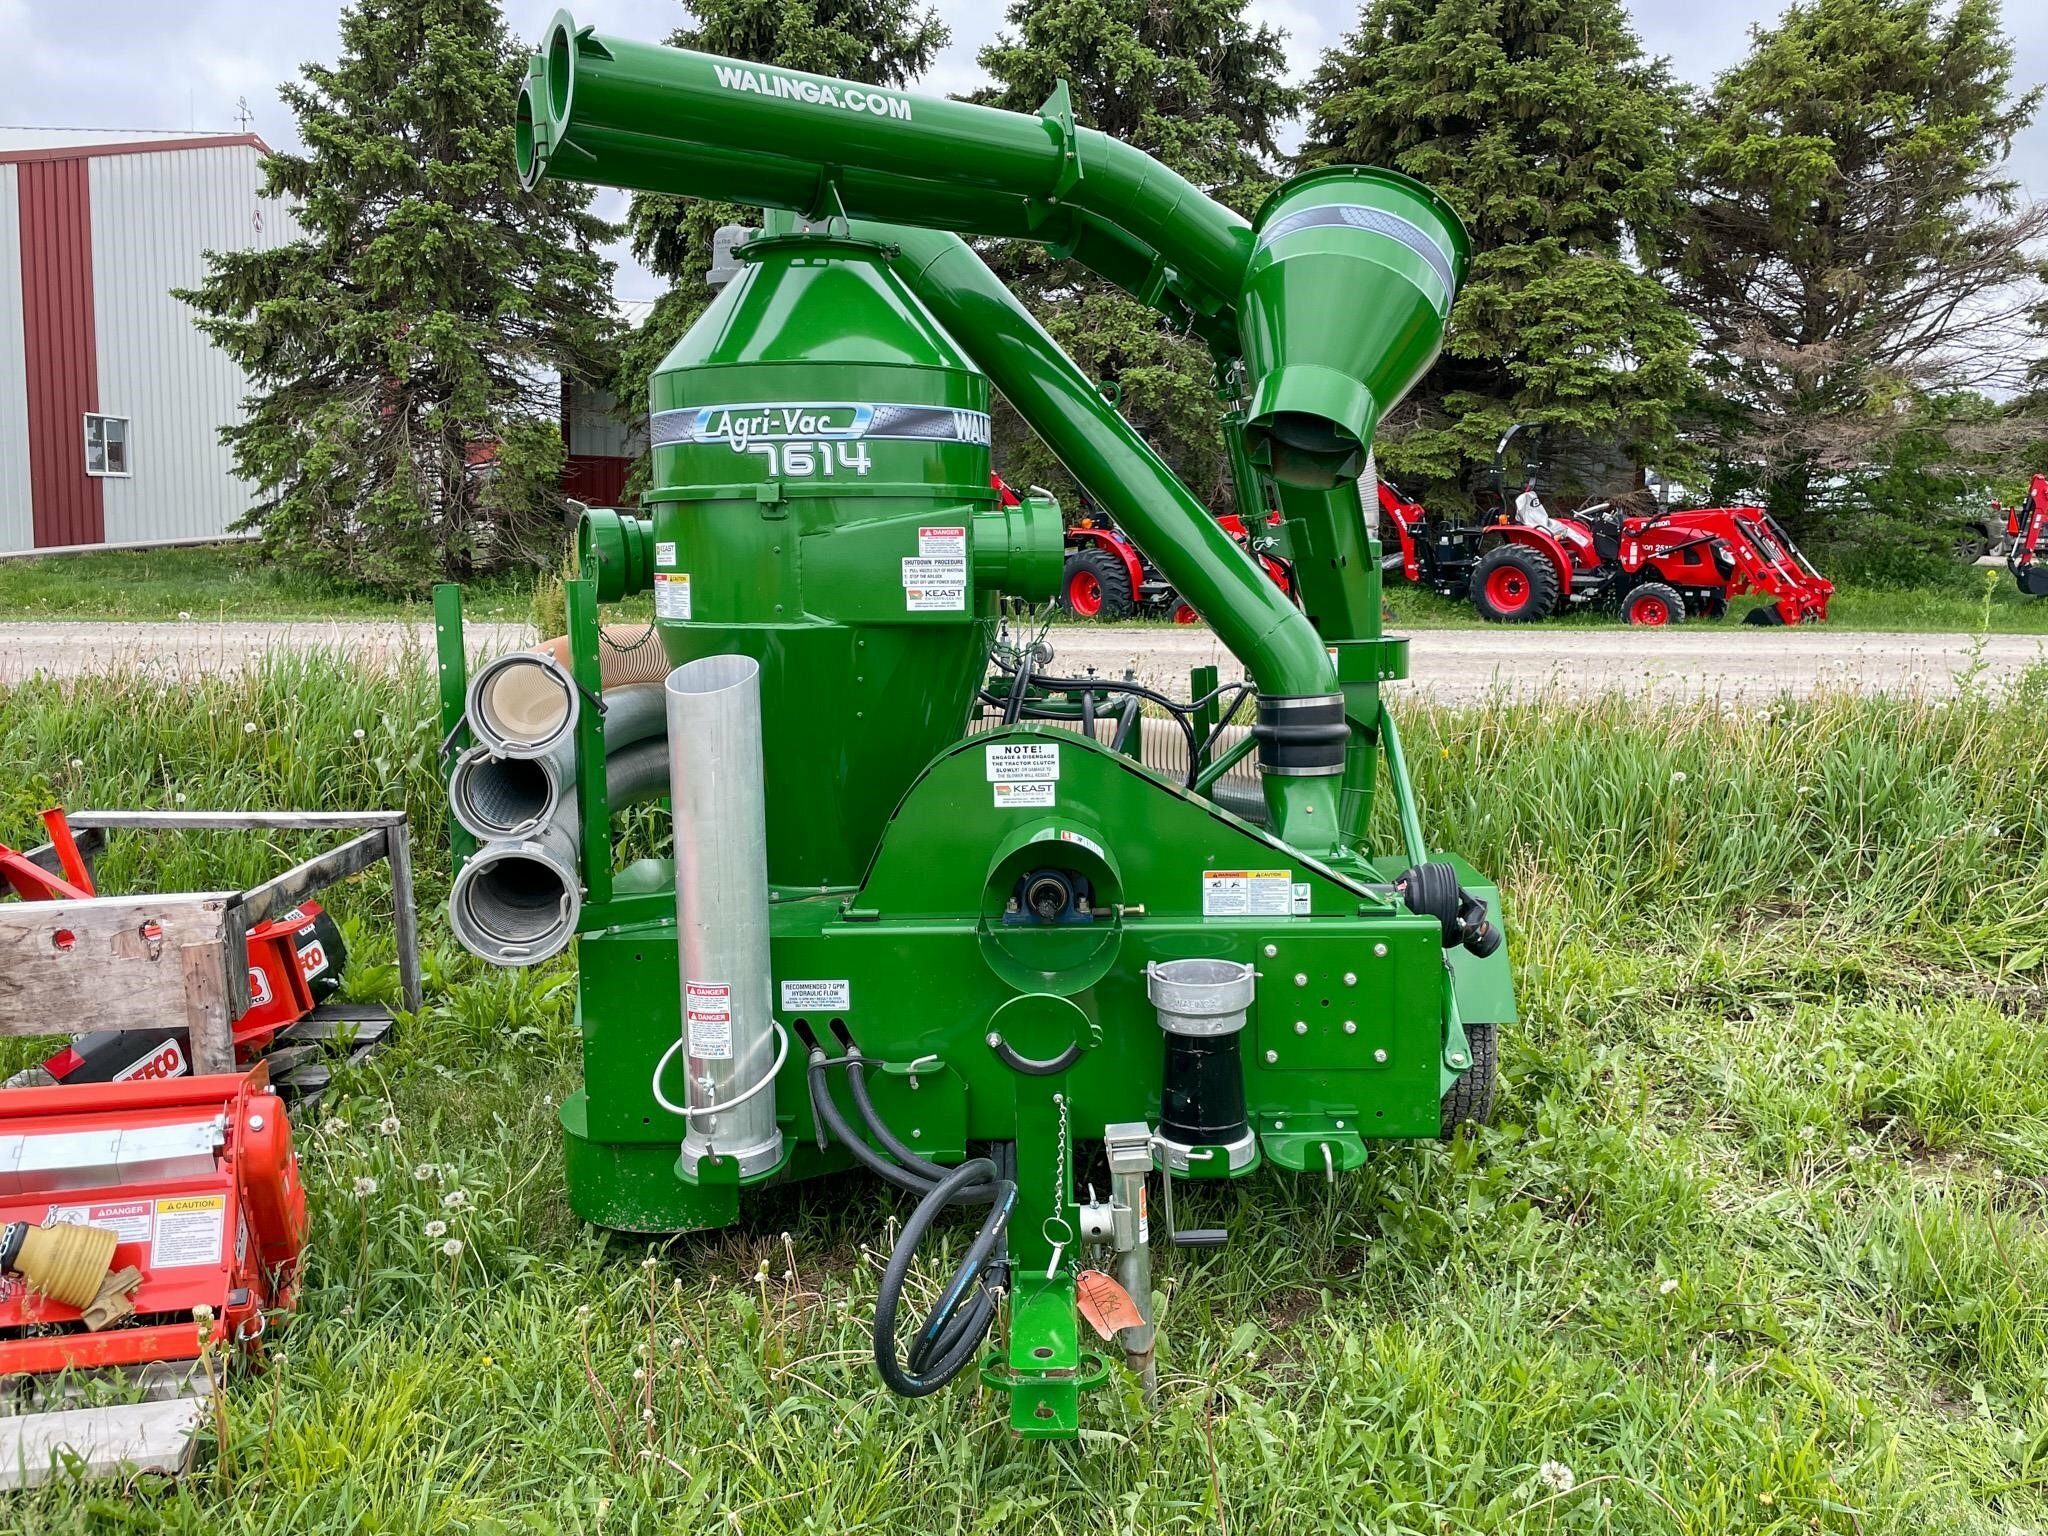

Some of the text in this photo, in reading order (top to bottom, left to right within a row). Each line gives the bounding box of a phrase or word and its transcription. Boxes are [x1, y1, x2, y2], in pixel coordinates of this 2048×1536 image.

[715, 408, 832, 453] Agri-Vac
[747, 441, 872, 477] 7614
[1005, 746, 1042, 754] NOTE!
[1014, 784, 1052, 792] KEAST
[696, 988, 725, 996] DANGER
[697, 1013, 725, 1021] DANGER
[175, 1199, 215, 1210] CAUTION
[105, 1206, 144, 1217] DANGER
